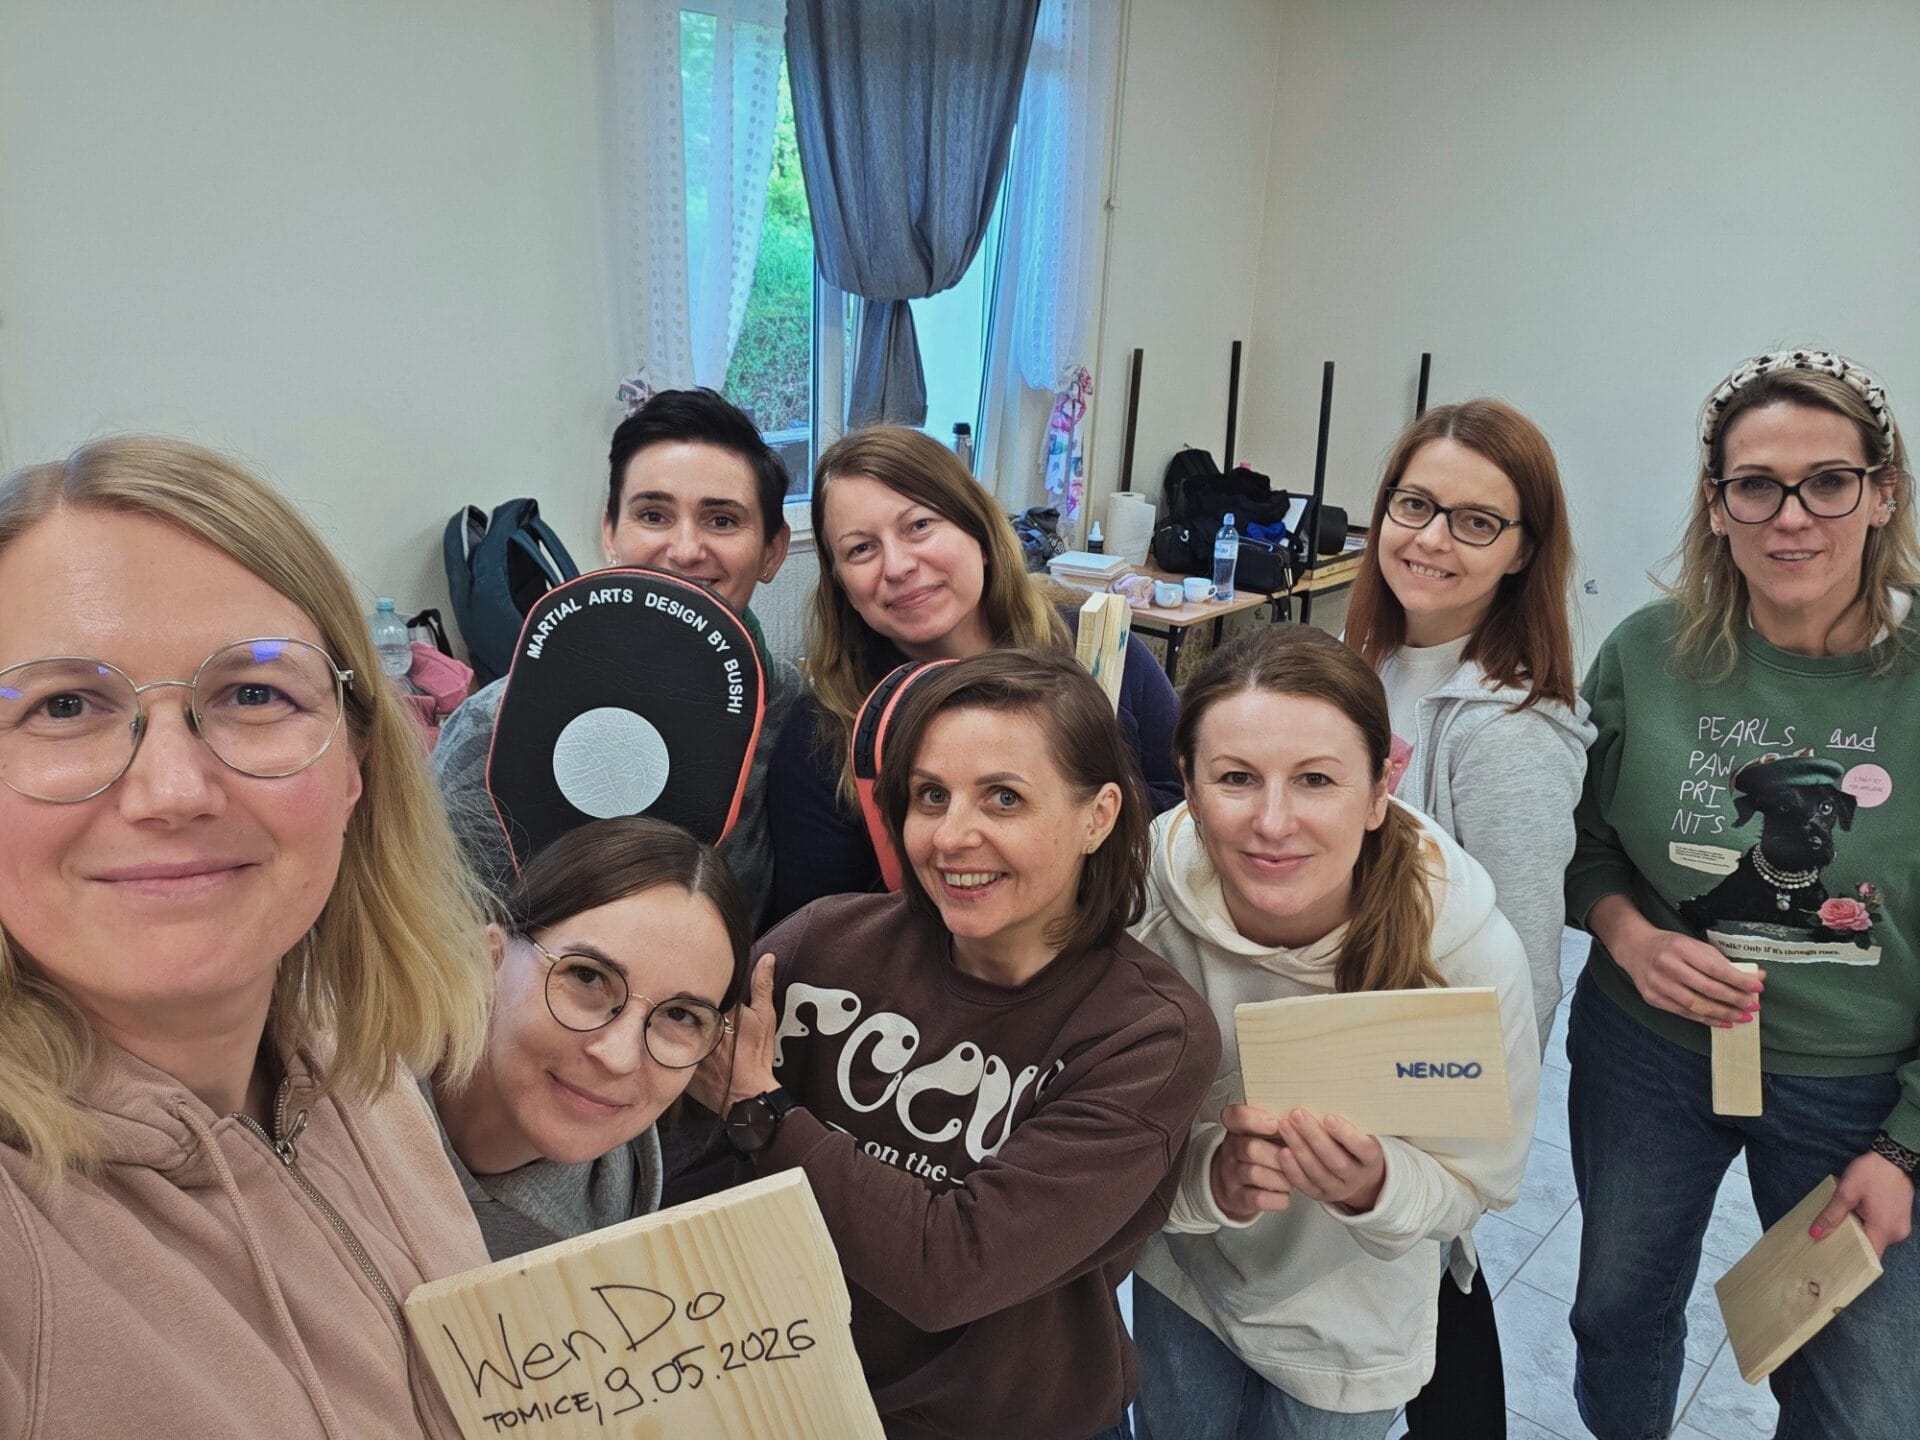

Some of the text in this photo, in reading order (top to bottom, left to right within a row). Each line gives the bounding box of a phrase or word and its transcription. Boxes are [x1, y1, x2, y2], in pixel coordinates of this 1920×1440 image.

[527, 588, 743, 714] MARTIAL ARTS DESIGN BY BUSHI
[1698, 716, 1877, 751] PEARLS and
[1689, 750, 1734, 777] PAW
[1679, 780, 1726, 809] PRI
[1671, 808, 1725, 834] NTS
[1717, 939, 1742, 950] Walk?
[1743, 944, 1761, 954] Only
[1395, 1061, 1483, 1080] WENDO
[864, 1141, 947, 1182] on the
